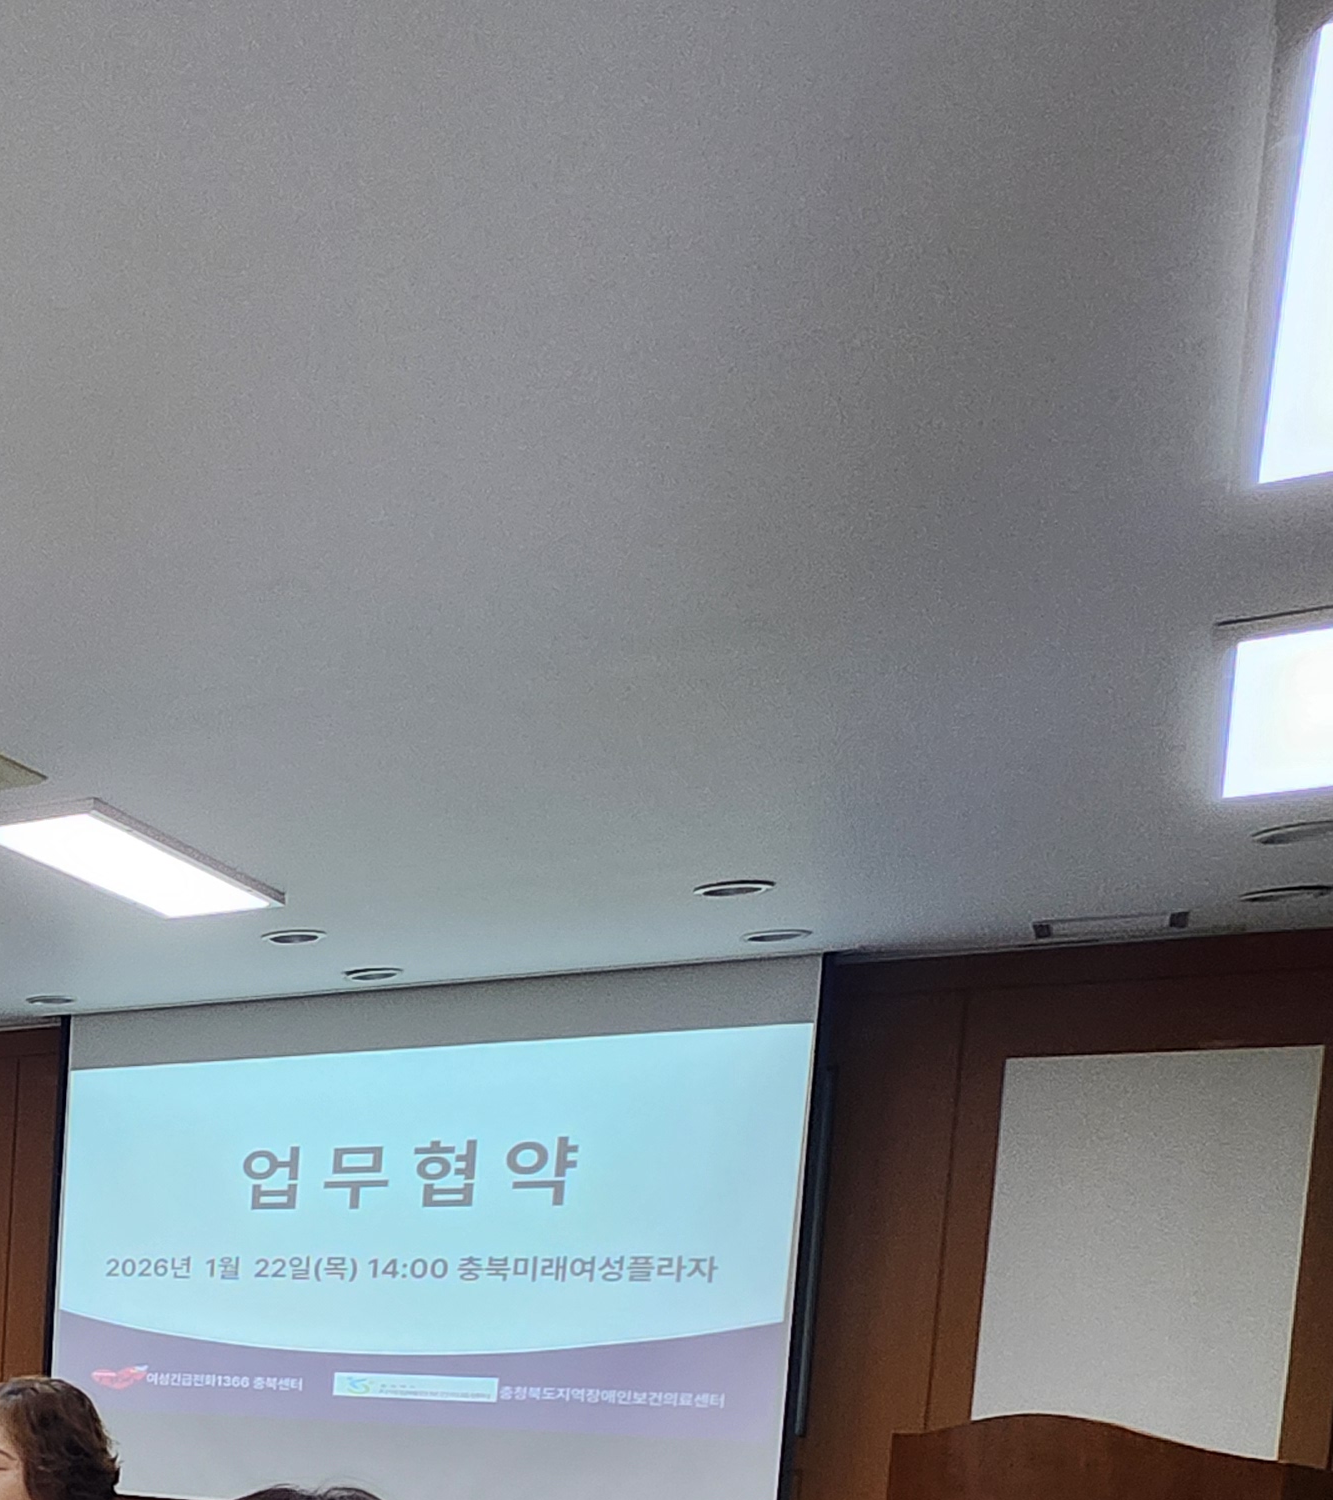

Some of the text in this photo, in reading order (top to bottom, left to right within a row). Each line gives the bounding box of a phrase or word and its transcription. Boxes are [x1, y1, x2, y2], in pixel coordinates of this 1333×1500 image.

[105, 1254, 719, 1285] 2026년 1월 22일(목) 14:00 충북미래여성플라자
